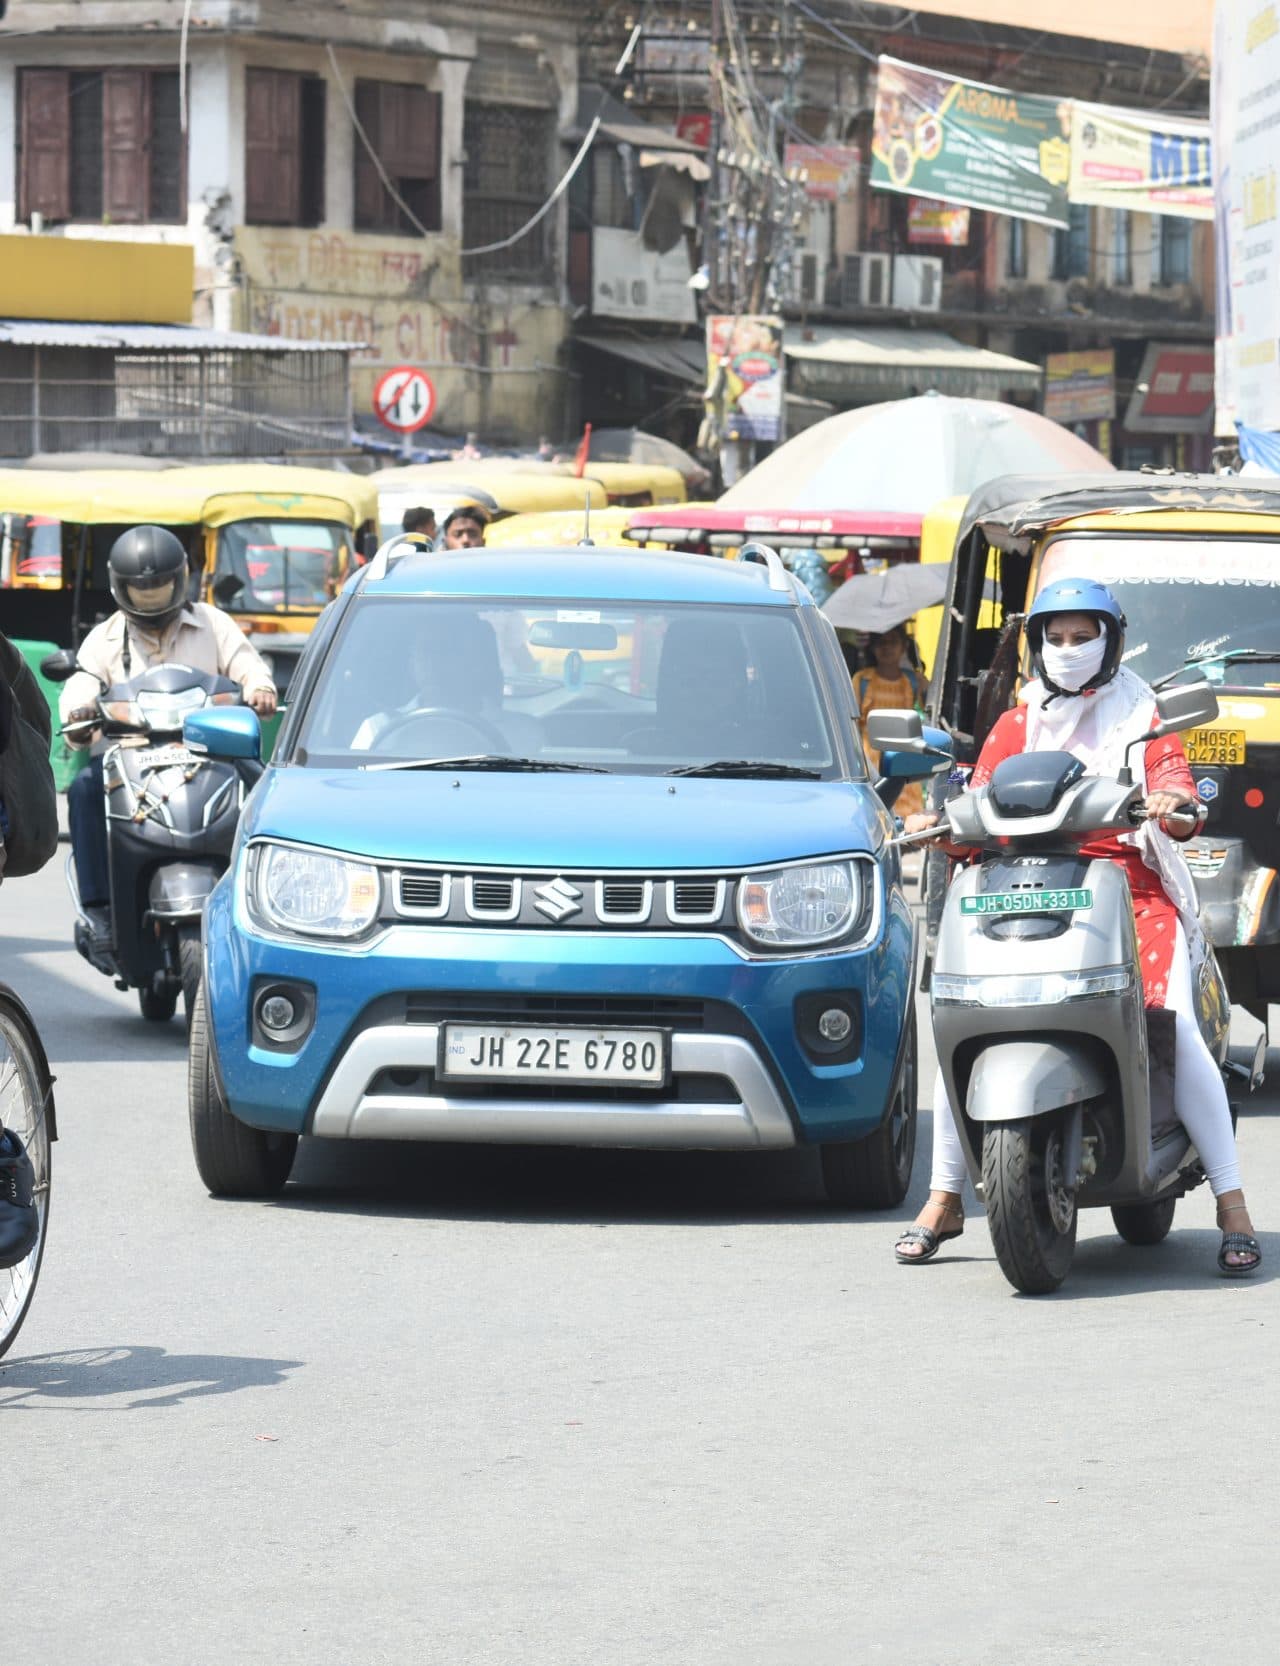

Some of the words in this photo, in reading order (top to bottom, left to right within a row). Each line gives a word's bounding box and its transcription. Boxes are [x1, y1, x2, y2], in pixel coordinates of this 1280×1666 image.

[957, 88, 1019, 122] AROMA
[1190, 731, 1237, 747] JH05C
[1022, 857, 1048, 866] TVS
[449, 1045, 465, 1055] IND
[470, 1036, 504, 1067] JH
[517, 1038, 570, 1069] 22E
[584, 1040, 656, 1071] 6780
